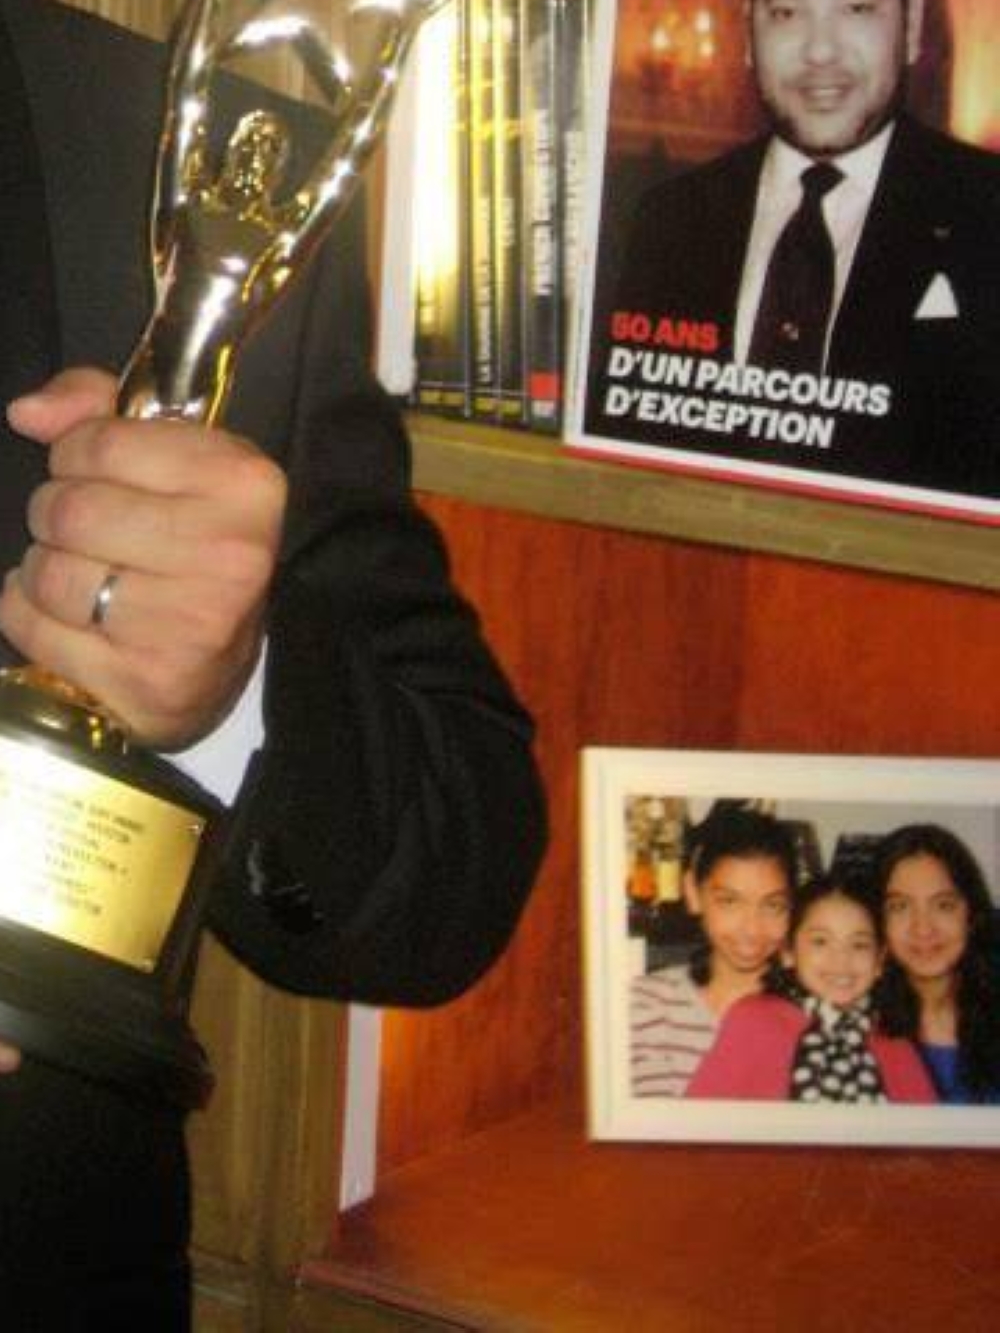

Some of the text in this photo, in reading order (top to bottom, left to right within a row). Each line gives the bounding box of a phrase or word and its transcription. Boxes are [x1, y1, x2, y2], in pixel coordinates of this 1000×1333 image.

[610, 312, 719, 353] 50 ANS
[607, 347, 892, 417] D'UN PARCOURS
[604, 385, 836, 449] D'EXCEPTION
